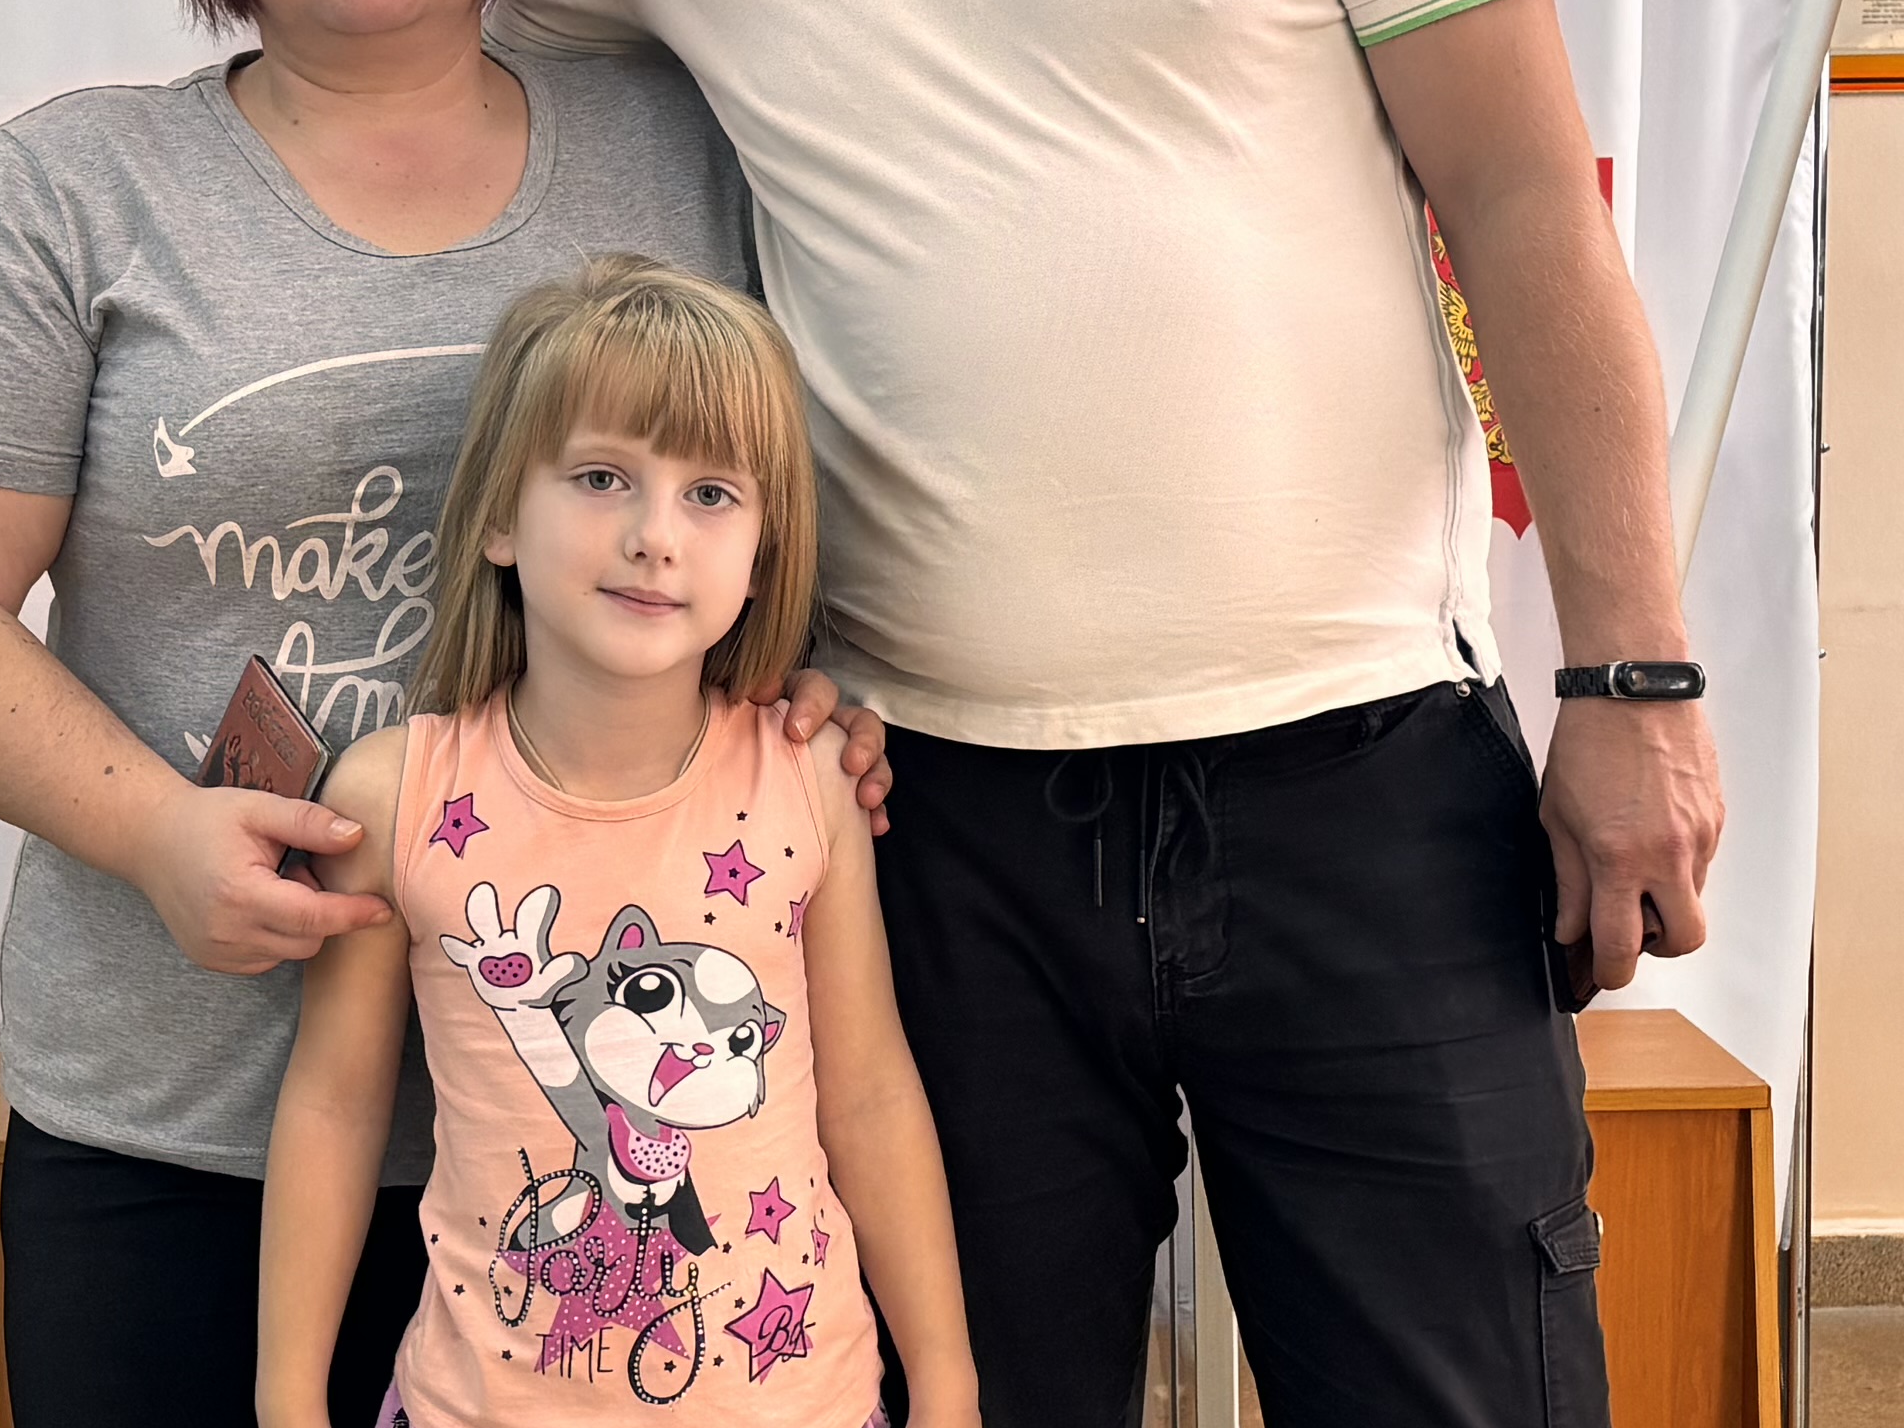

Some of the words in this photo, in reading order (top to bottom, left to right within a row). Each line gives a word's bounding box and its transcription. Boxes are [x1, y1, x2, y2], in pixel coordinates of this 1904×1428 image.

[141, 465, 441, 603] make
[489, 1147, 735, 1407] Party
[535, 1326, 614, 1383] TIME
